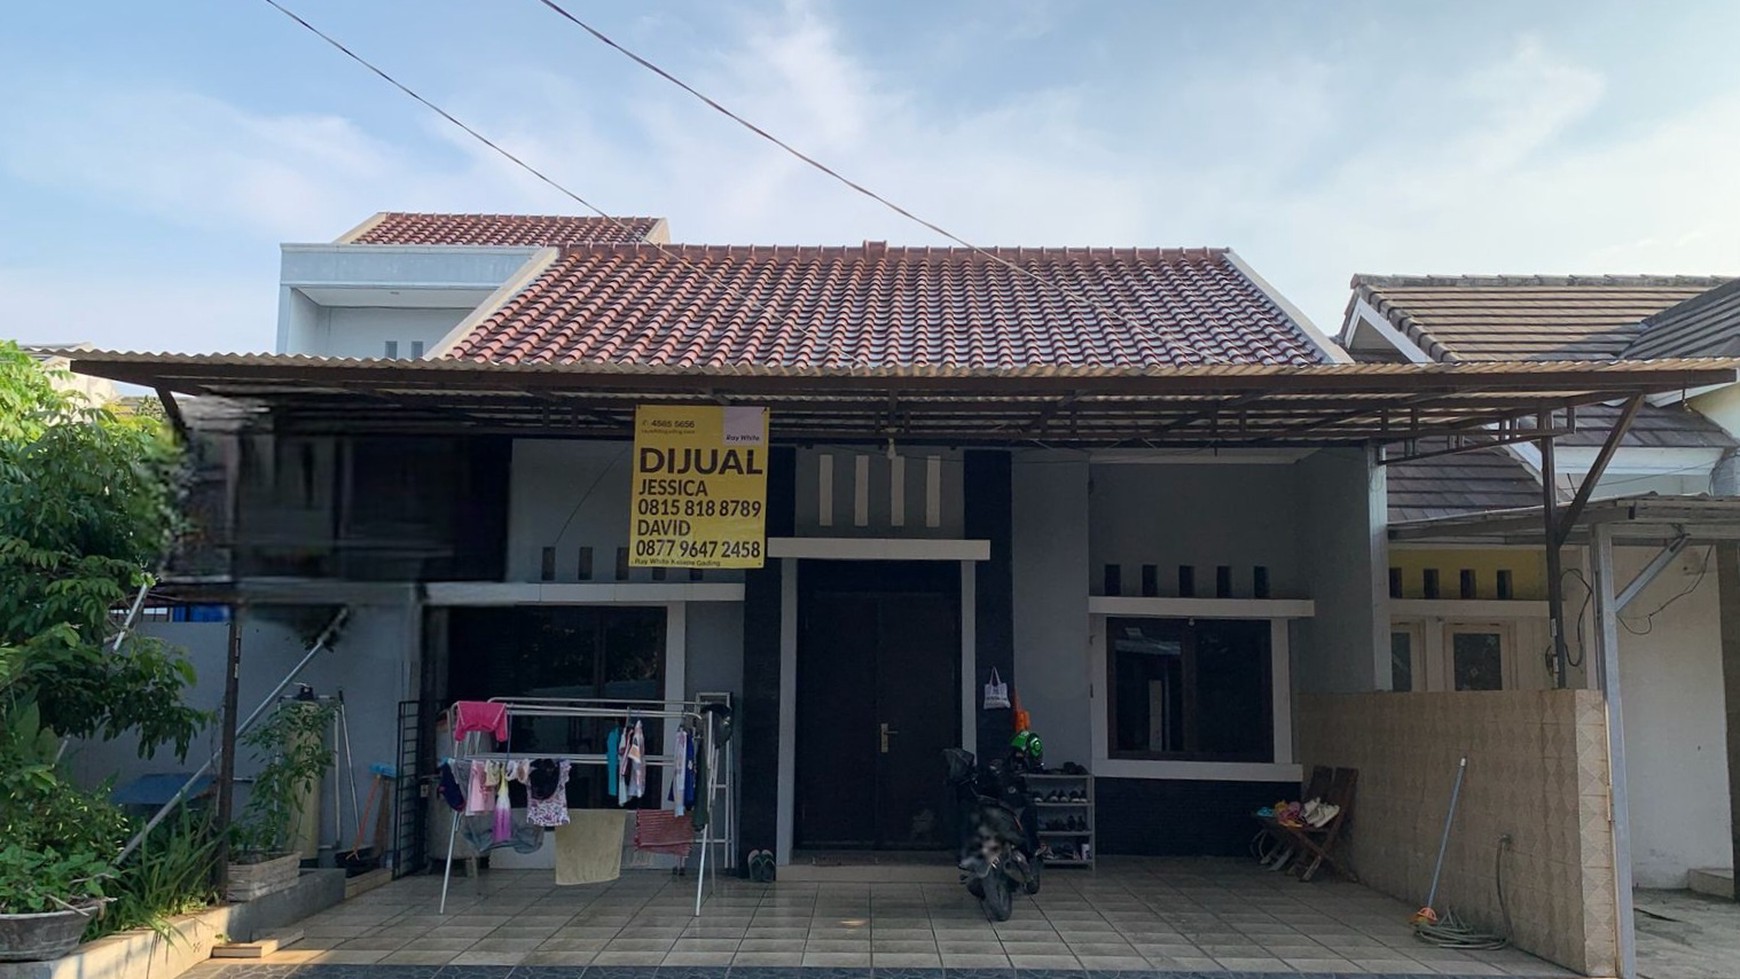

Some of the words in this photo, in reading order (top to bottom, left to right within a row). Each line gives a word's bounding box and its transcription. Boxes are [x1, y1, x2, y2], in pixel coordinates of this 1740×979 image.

[640, 448, 763, 475] DIJUAL
[639, 479, 708, 496] JESSICA
[638, 499, 680, 516] 0815
[684, 500, 715, 516] 818
[719, 500, 761, 517] 8789
[637, 519, 691, 536] DAVID
[636, 540, 676, 556] 0877
[680, 541, 718, 557] 9647
[721, 541, 761, 558] 2458
